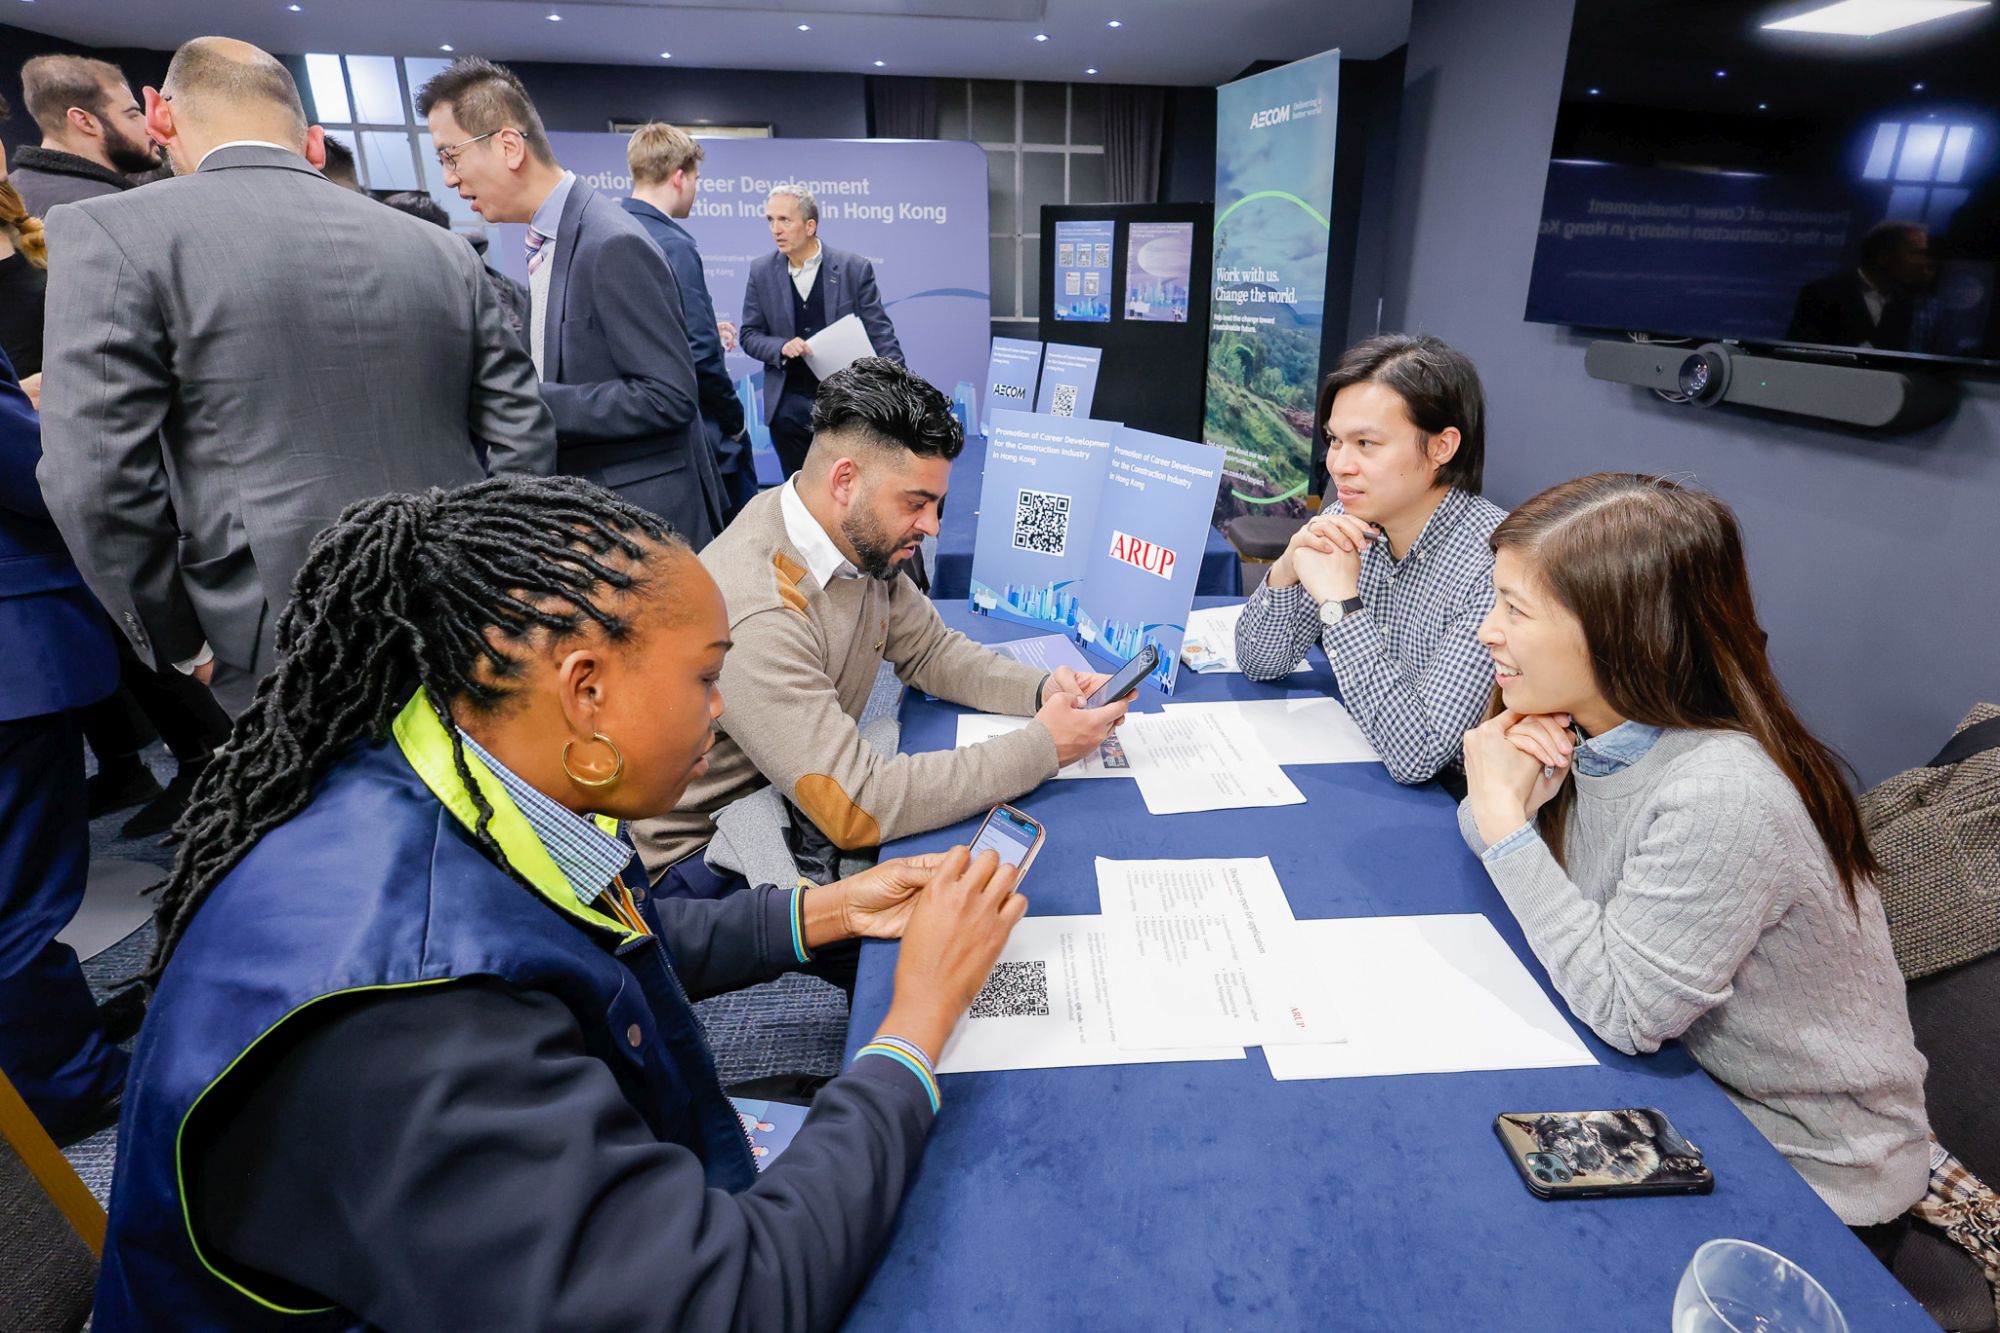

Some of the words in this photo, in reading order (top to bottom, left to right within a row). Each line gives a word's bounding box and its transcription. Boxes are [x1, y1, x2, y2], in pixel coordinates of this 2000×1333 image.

[1250, 104, 1290, 130] AECOM
[577, 171, 633, 190] otion
[695, 177, 735, 193] reer
[822, 201, 838, 219] in
[844, 203, 894, 224] Hong
[899, 204, 947, 225] Kong
[1216, 267, 1240, 282] Work
[1242, 266, 1264, 282] with
[1266, 270, 1280, 282] us.
[1215, 286, 1248, 306] Change
[1250, 286, 1266, 303] the
[1268, 287, 1298, 304] world.
[993, 384, 1026, 399] AECOM
[996, 428, 1030, 439] Promotion
[1040, 433, 1064, 442] Career
[1064, 436, 1110, 448] Developmen
[1000, 452, 1018, 463] Hong
[1019, 455, 1036, 465] Kong
[1006, 441, 1016, 449] the
[1018, 443, 1060, 454] Construction
[1062, 448, 1090, 460] Industry
[1114, 446, 1142, 460] Promotion
[1143, 454, 1150, 462] of
[1150, 456, 1171, 467] Career
[1171, 460, 1214, 478] Development
[1109, 472, 1114, 480] in
[1115, 474, 1130, 486] Hong
[1130, 478, 1145, 491] Kong
[1112, 458, 1120, 468] for
[1121, 461, 1130, 470] the
[1131, 464, 1166, 480] Construction
[1167, 474, 1192, 490] Industry
[1110, 534, 1174, 575] ARUP
[1291, 1008, 1306, 1028] ARUP
